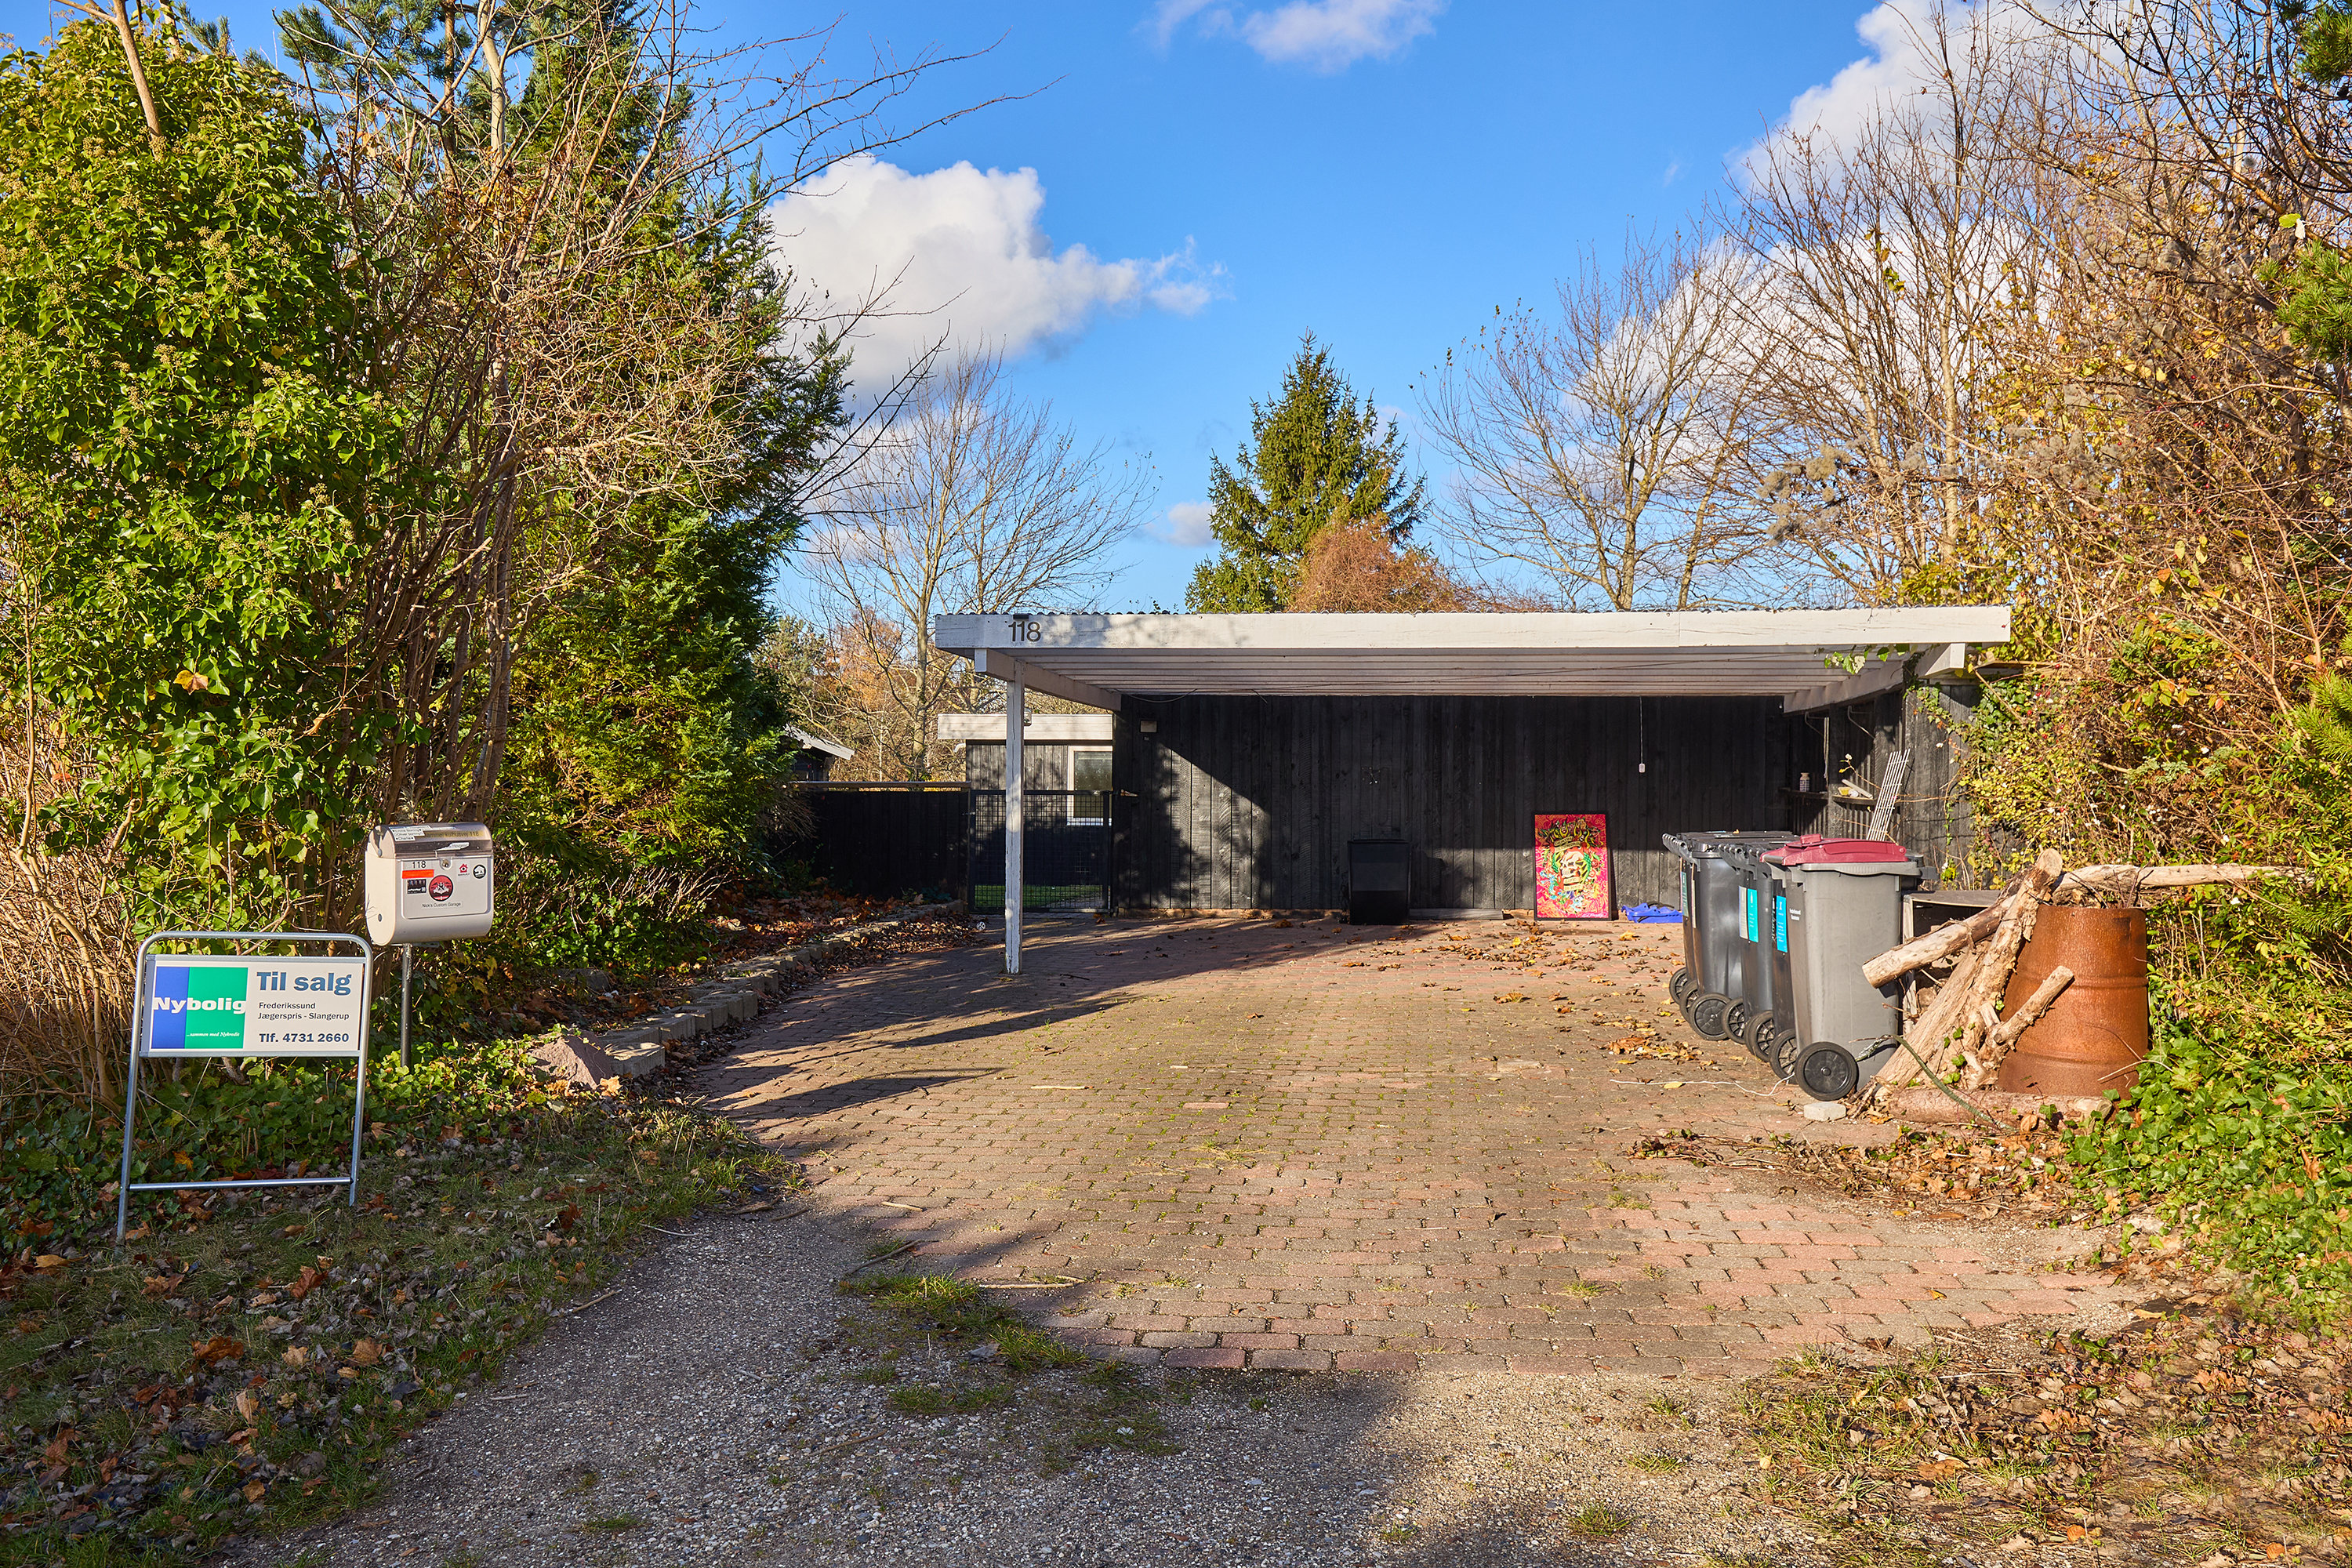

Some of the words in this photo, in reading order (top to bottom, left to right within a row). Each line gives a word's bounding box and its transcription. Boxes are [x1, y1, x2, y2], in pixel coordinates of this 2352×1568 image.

[1008, 621, 1041, 642] 118
[412, 860, 426, 869] 118
[256, 971, 287, 991] Til
[293, 972, 352, 996] salg
[152, 997, 247, 1014] Nybolig
[308, 1012, 350, 1021] Slangerup
[259, 1033, 279, 1042] Tlf.
[282, 1033, 314, 1042] 4731
[318, 1033, 350, 1042] 2660
